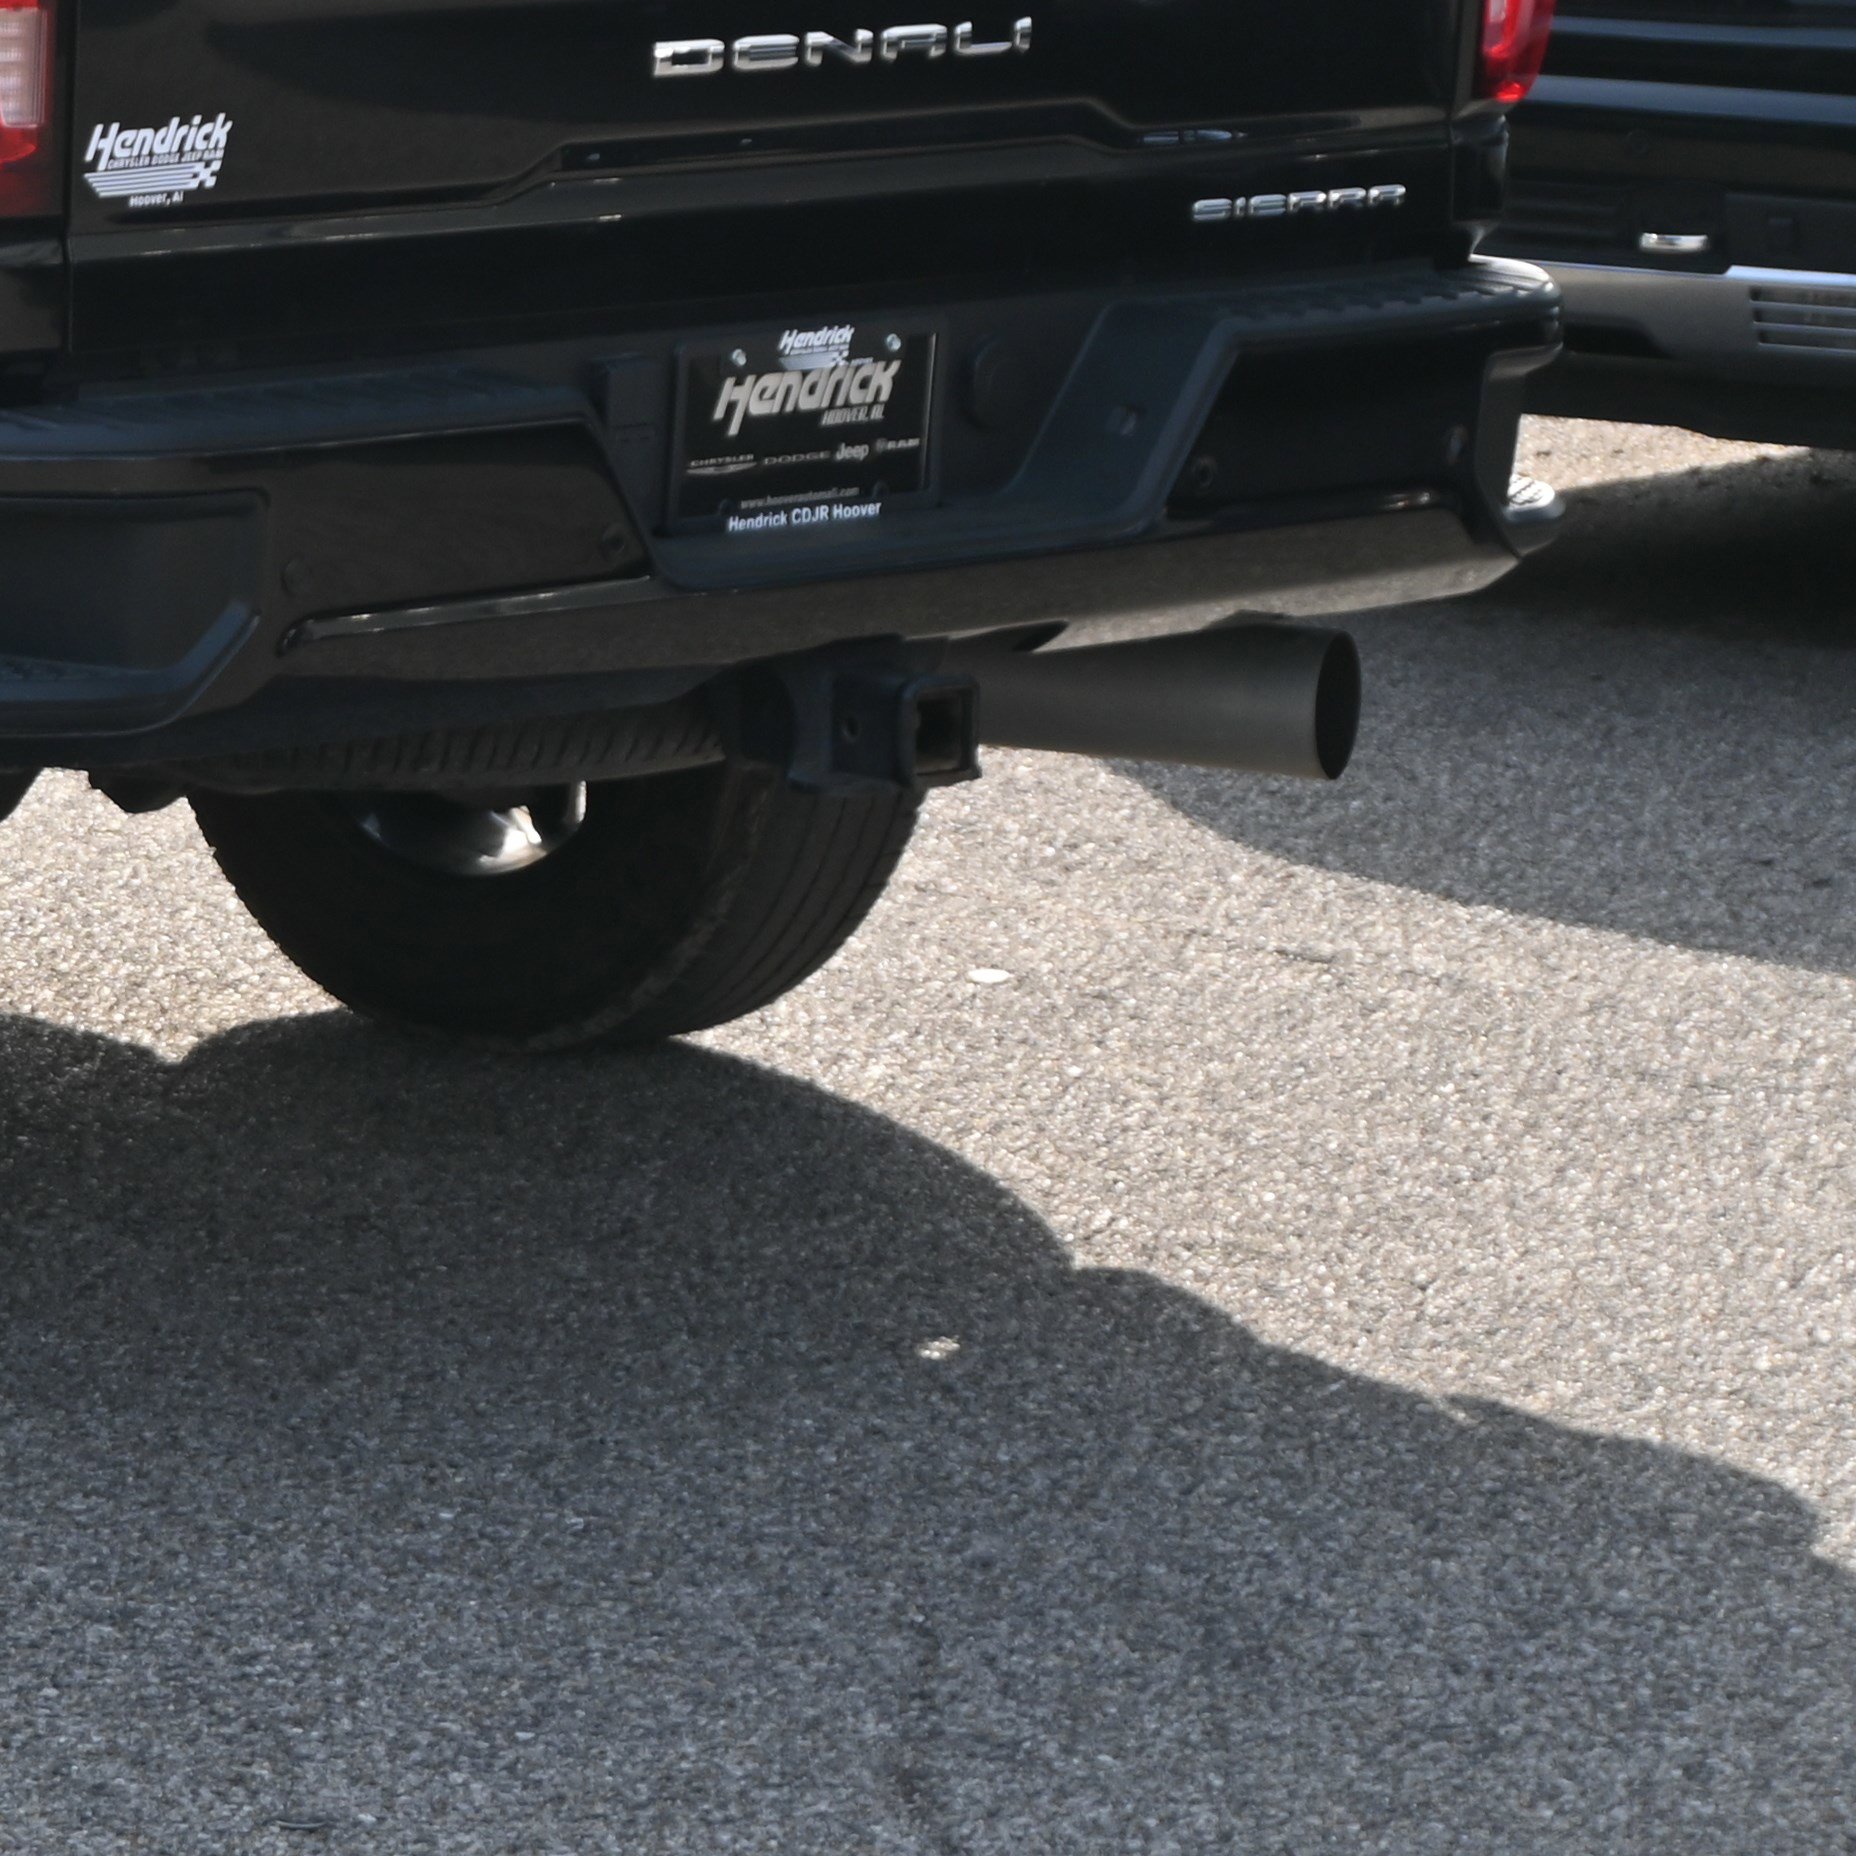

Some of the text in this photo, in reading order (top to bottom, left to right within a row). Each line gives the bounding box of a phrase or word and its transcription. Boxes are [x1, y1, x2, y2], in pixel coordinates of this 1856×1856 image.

[651, 15, 1033, 79] DENALI
[85, 113, 233, 172] Hendrick
[107, 155, 150, 169] CHRYSLER
[181, 150, 202, 162] JEEP
[1190, 182, 1408, 223] SIERRA
[778, 324, 855, 355] Hendrick
[713, 360, 902, 436] Hendrick
[763, 451, 831, 465] DODGE
[835, 443, 869, 461] Jeep
[888, 438, 920, 449] RAM
[728, 502, 882, 532] Hendrick CDJR Hoover
